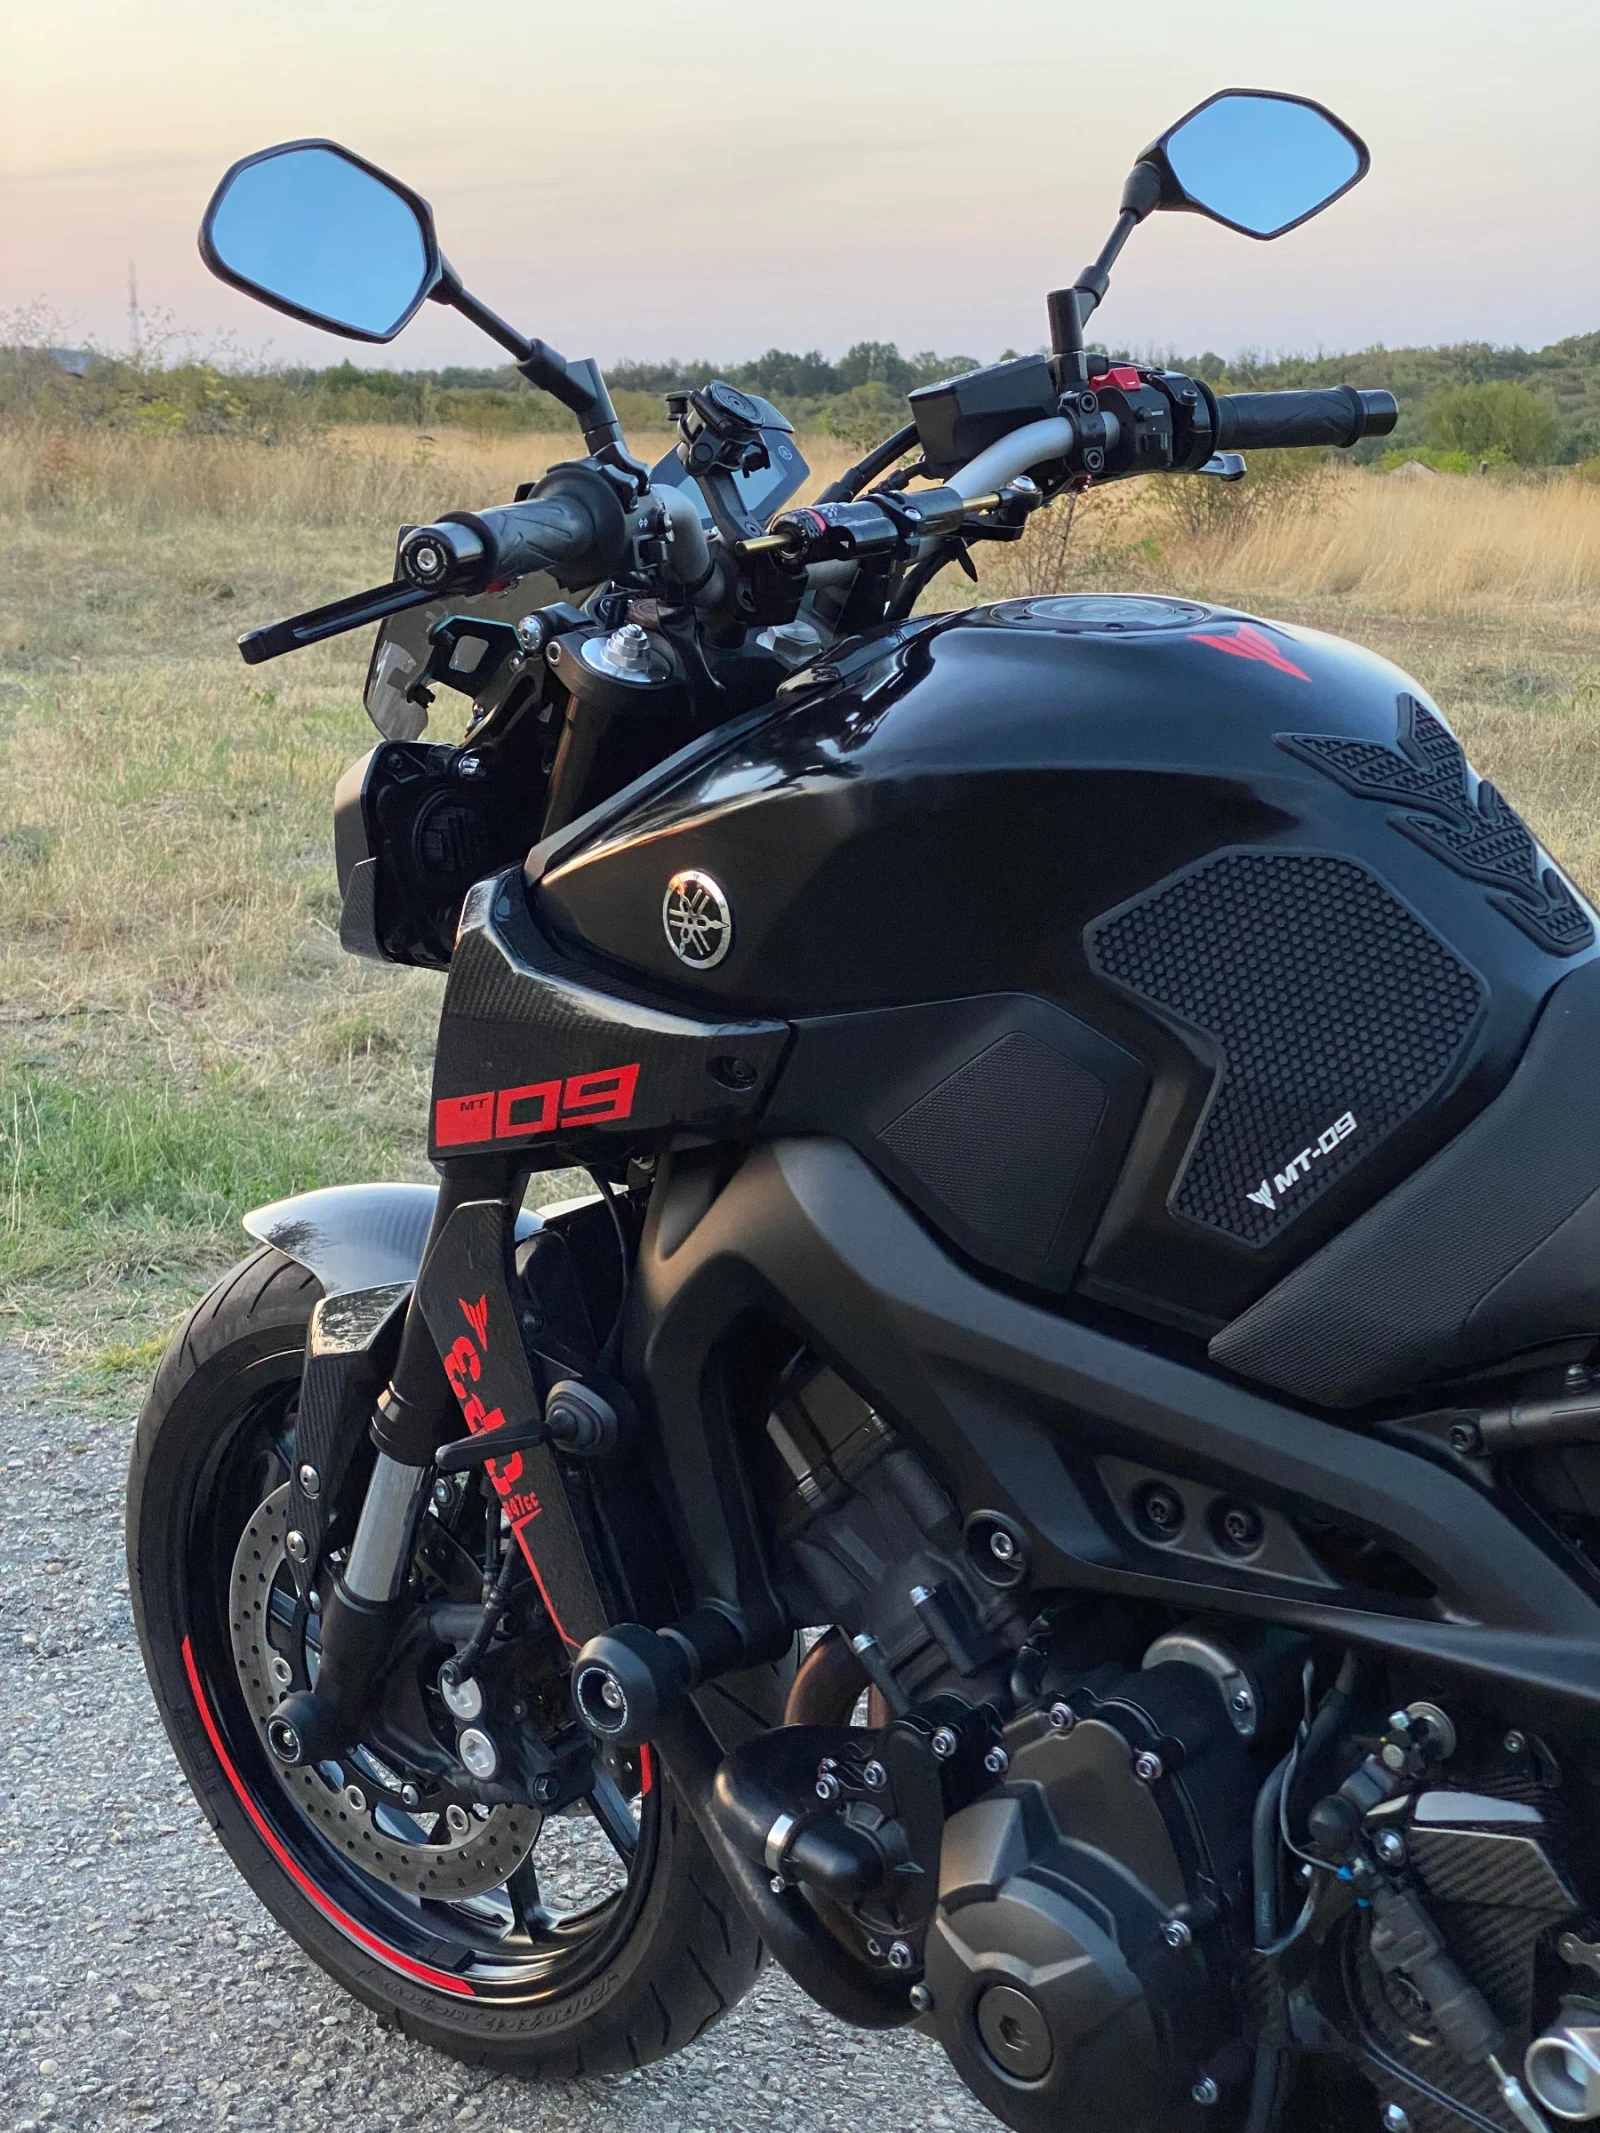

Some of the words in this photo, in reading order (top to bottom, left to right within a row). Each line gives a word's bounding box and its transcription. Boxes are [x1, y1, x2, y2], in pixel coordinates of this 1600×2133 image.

[460, 1097, 489, 1112] MT
[495, 1063, 640, 1138] 09
[1273, 1111, 1357, 1194] MT-09
